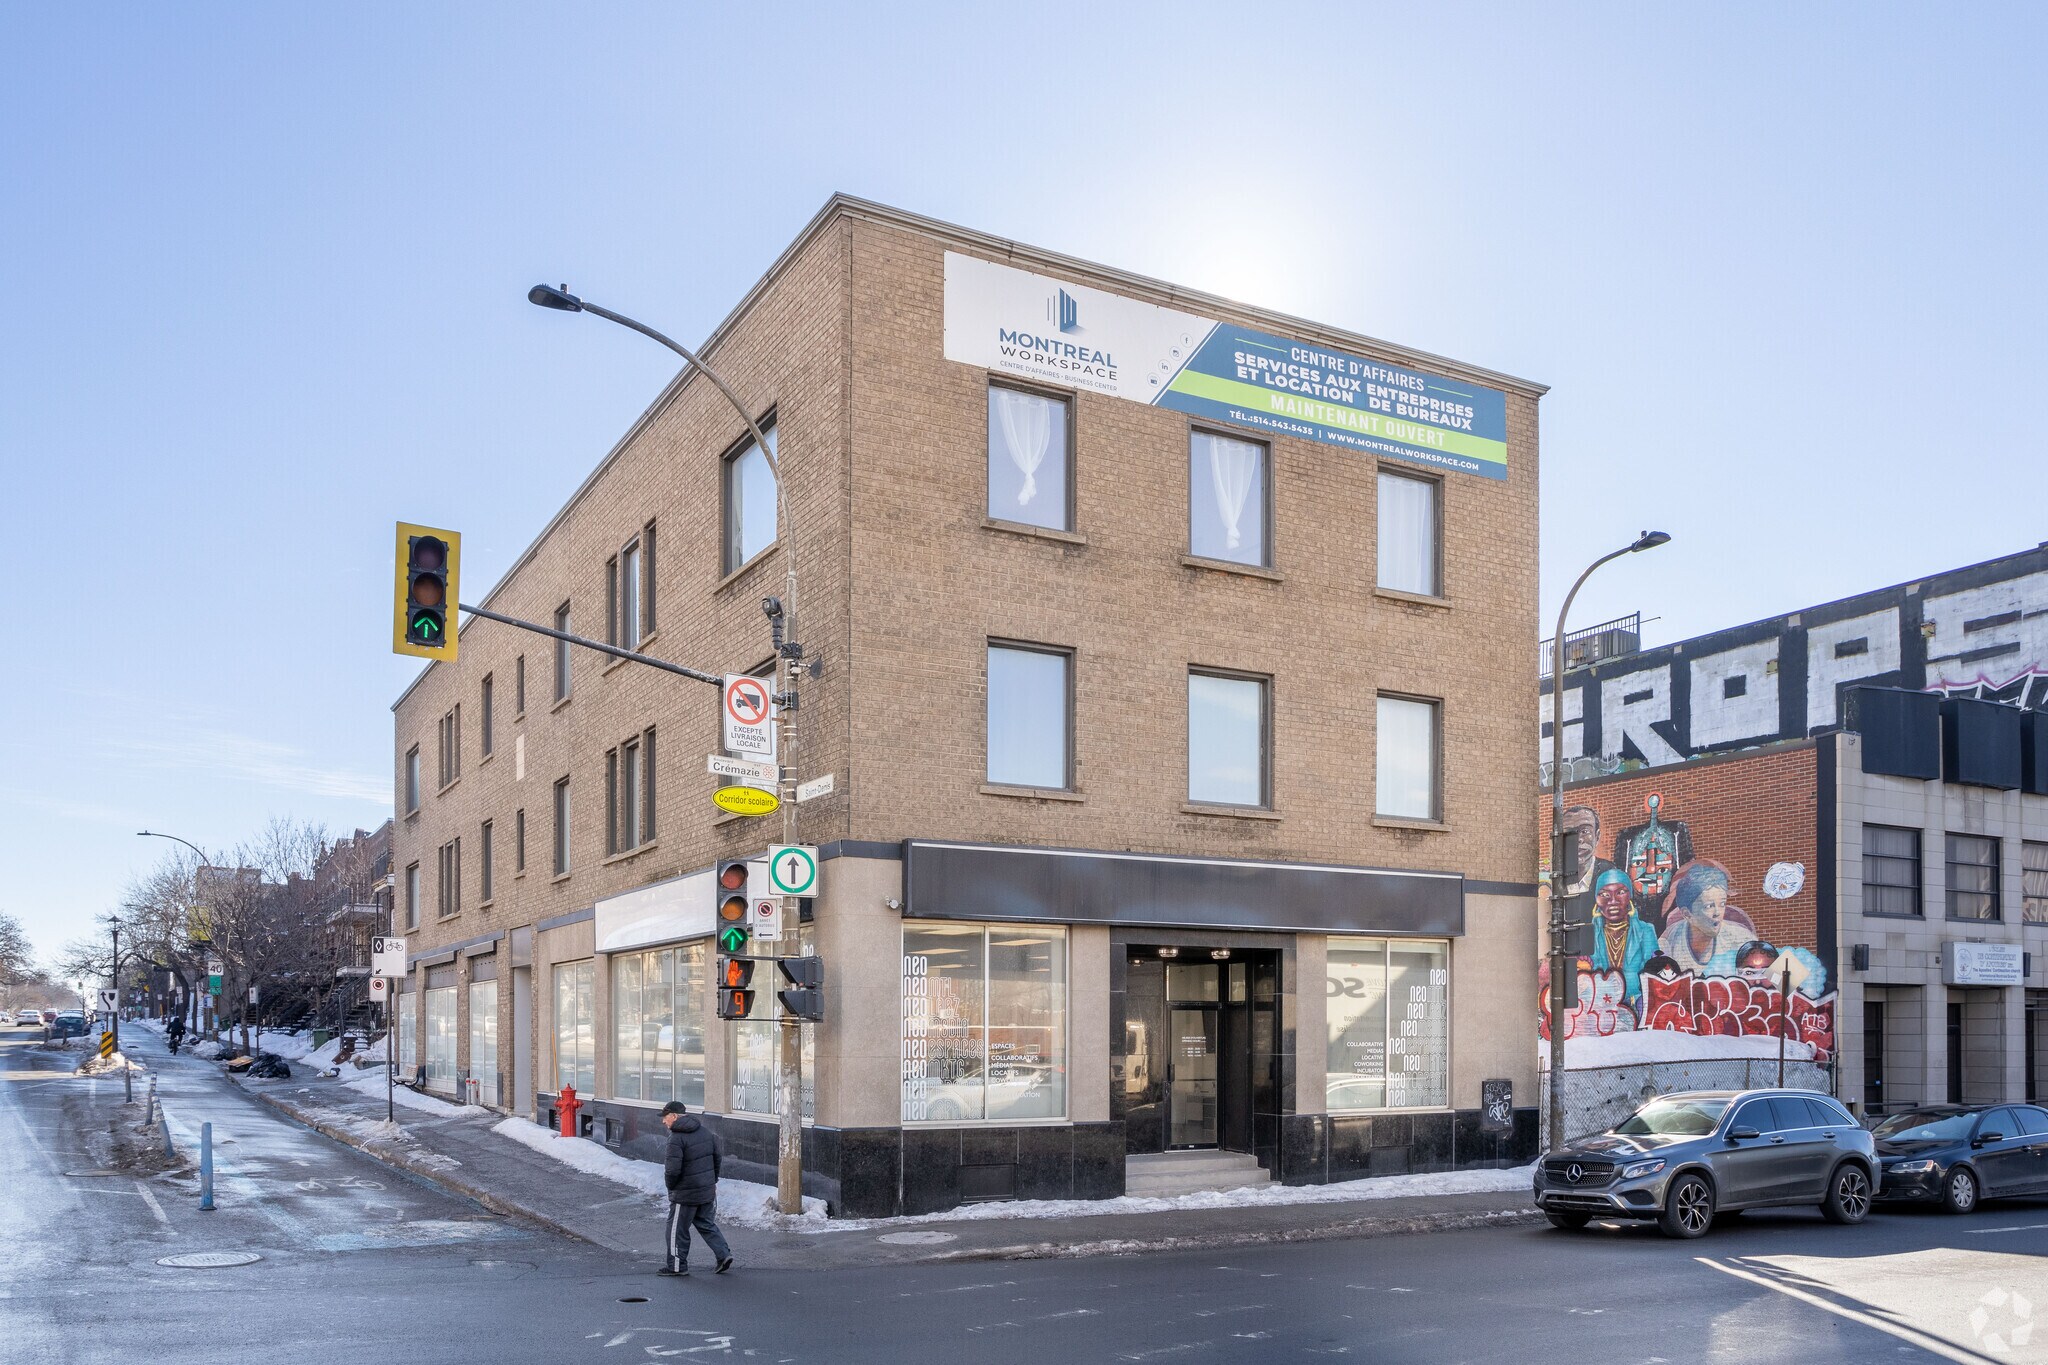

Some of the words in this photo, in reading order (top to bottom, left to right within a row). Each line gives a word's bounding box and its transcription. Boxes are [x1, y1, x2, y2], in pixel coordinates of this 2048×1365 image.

[999, 327, 1118, 369] MONTREAL
[999, 345, 1118, 381] WORKSPACE
[1291, 347, 1345, 372] CENTRE
[1350, 363, 1425, 392] D'AFFAIRES
[1000, 360, 1024, 372] CENTRE
[1025, 364, 1060, 380] D'AFFAIRES
[1064, 374, 1093, 387] BUSINESS
[1093, 380, 1118, 391] CENTER
[1234, 351, 1321, 383] SERVICES
[1325, 374, 1362, 392] AUX
[1367, 383, 1474, 418] ENTREPRISES
[1237, 365, 1260, 381] ET
[1265, 371, 1354, 404] LOCATION
[1369, 397, 1391, 412] DE
[1397, 403, 1473, 431] BUREAUX
[1270, 394, 1379, 432] MAINTENANT
[1386, 420, 1446, 447] OUVERT
[1327, 431, 1479, 471] WWW.MONTREALWORKSPACE.COM
[731, 732, 766, 743] LIVRAISON
[736, 740, 761, 749] LOCALE
[713, 761, 760, 777] Crémazie
[718, 793, 746, 805] Corridor
[748, 795, 774, 807] scolaire
[210, 964, 222, 973] 40
[904, 956, 927, 976] neo
[904, 976, 927, 996] neo
[1430, 969, 1446, 985] neo
[734, 992, 744, 1015] 9
[1410, 985, 1426, 1002] neo
[904, 997, 927, 1017] neo
[1407, 1003, 1423, 1019] neo
[904, 1018, 927, 1038] neo
[1400, 1020, 1417, 1036] neo
[904, 1039, 927, 1059] neo
[1389, 1037, 1405, 1054] neo
[904, 1059, 927, 1079] neo
[1403, 1054, 1420, 1071] neo
[904, 1080, 927, 1100] neo
[1389, 1072, 1405, 1089] neo
[732, 1085, 745, 1110] neo
[1389, 1089, 1405, 1106] neo
[904, 1101, 927, 1120] neo
